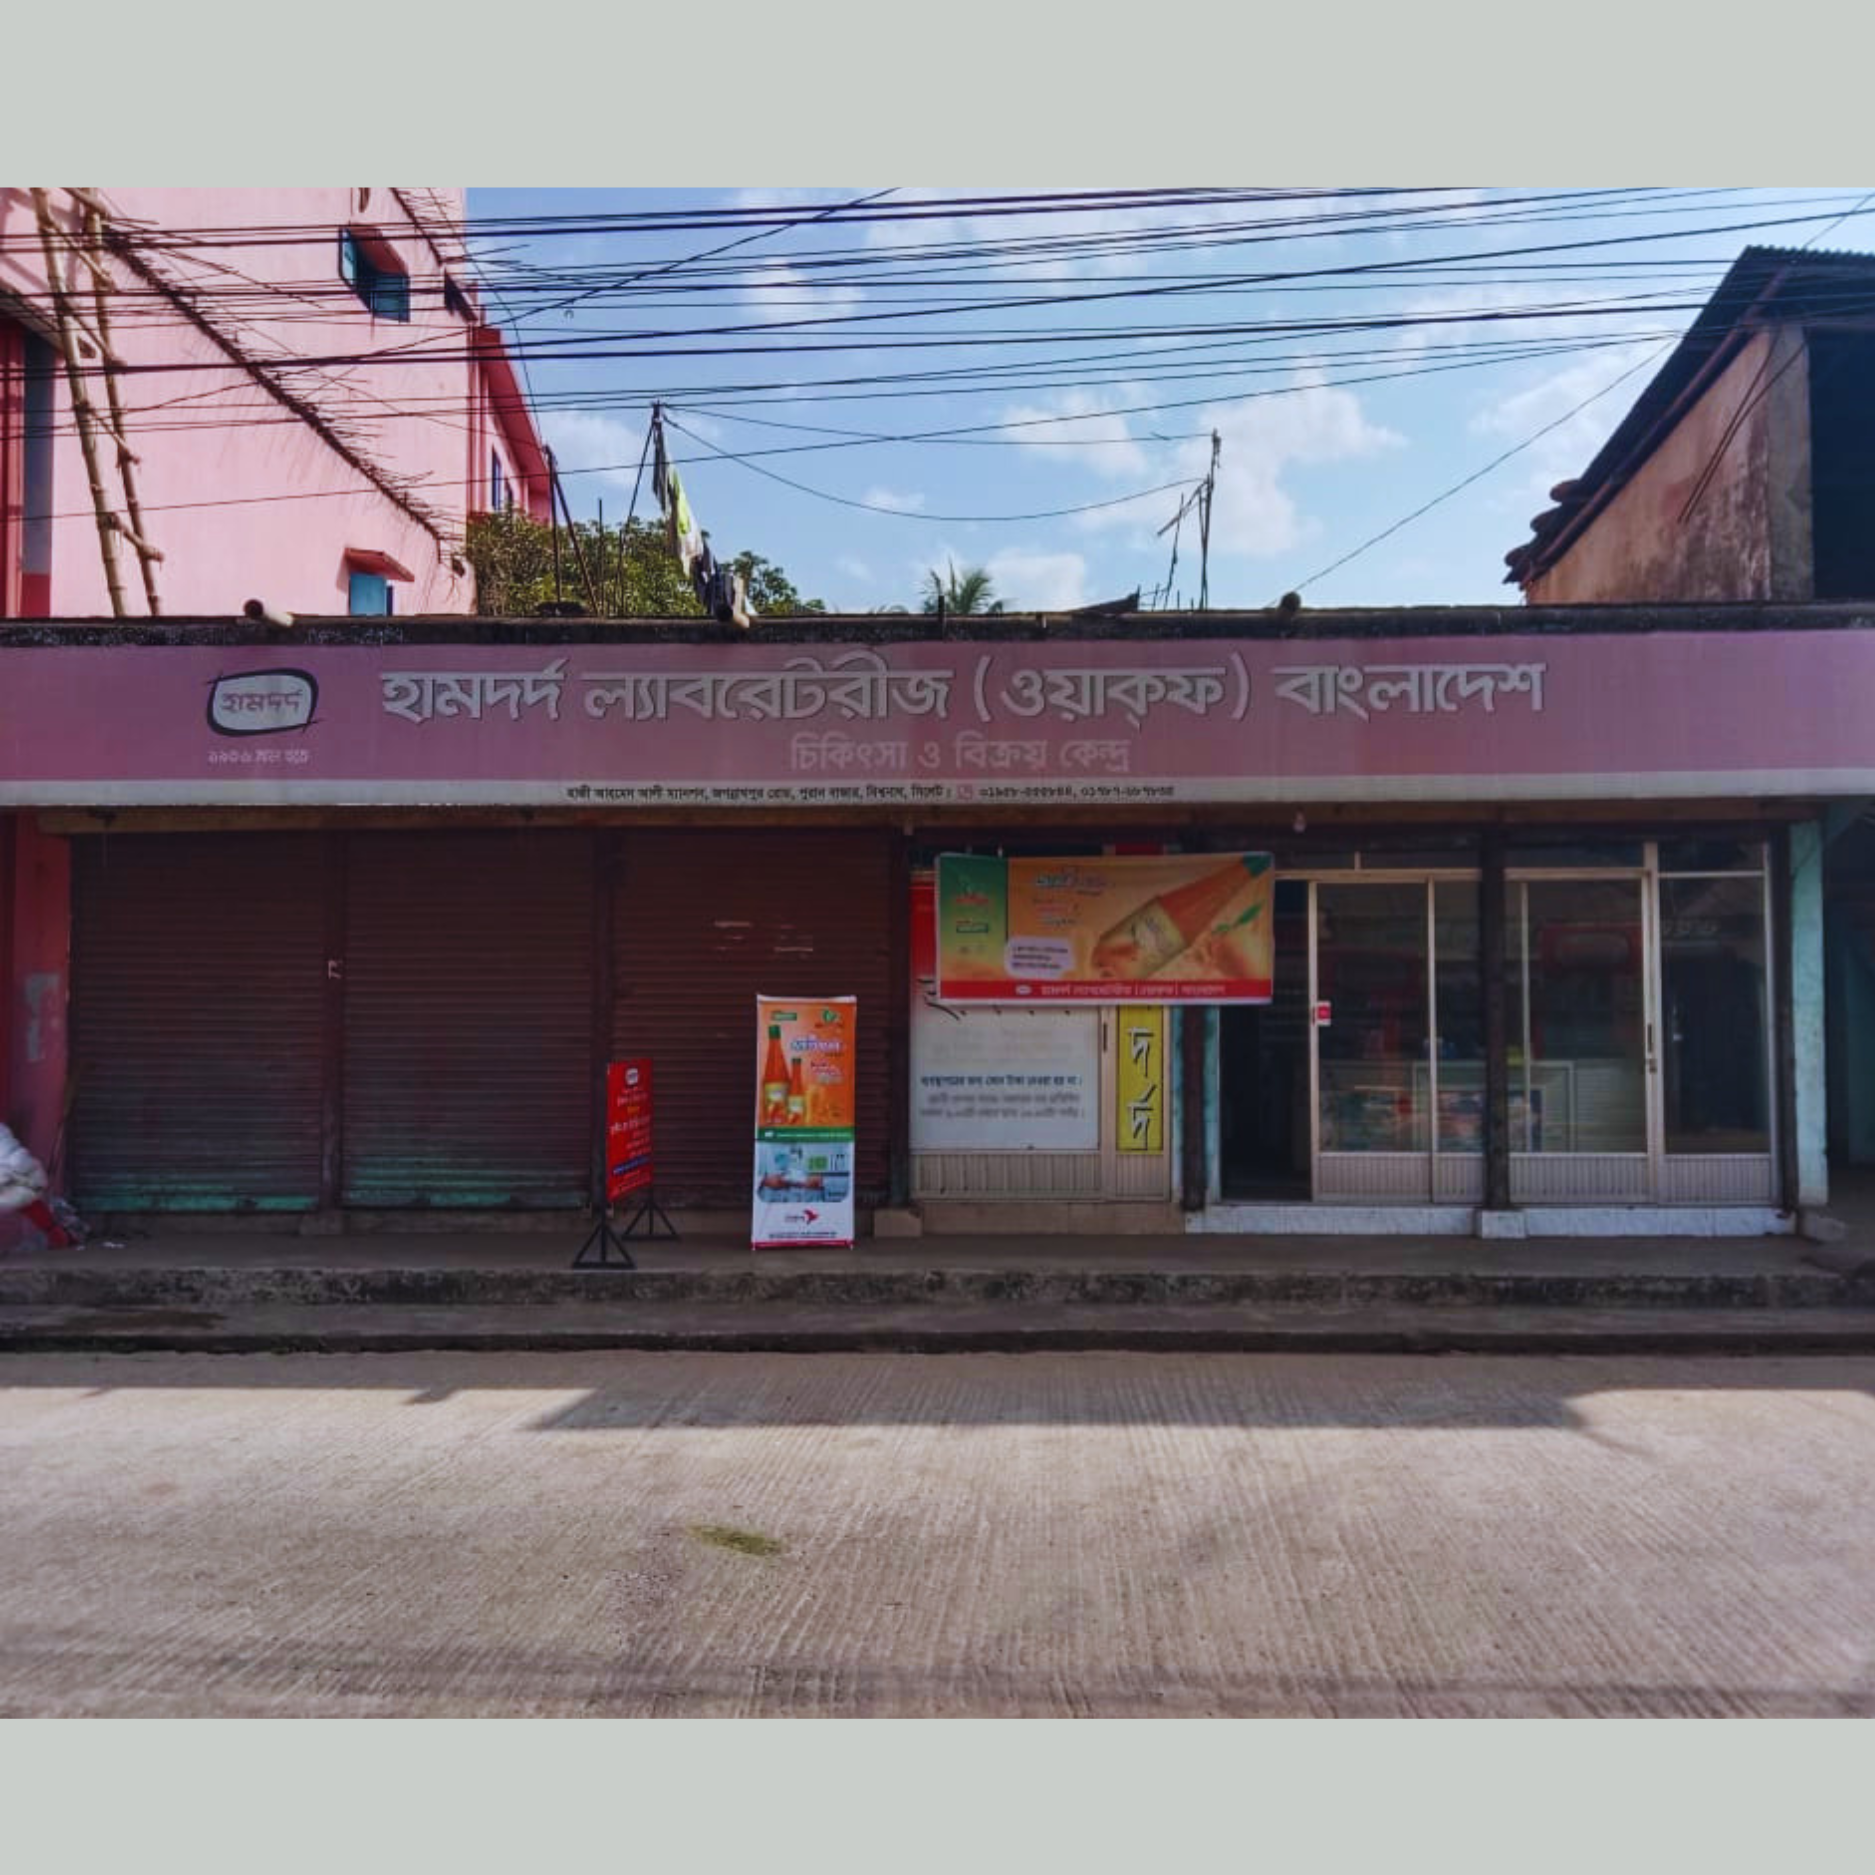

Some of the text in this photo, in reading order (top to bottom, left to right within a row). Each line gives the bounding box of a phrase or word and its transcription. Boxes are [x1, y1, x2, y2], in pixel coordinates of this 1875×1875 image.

[220, 687, 303, 714] হামদর্দ
[380, 657, 570, 724] হামদর্দ
[579, 649, 954, 721] ল্যাবরেটরীজ
[1271, 661, 1547, 723] বাংলাদেশ
[790, 730, 1131, 772] চিকিৎসা ও বিক্রয় কেন্দ্র
